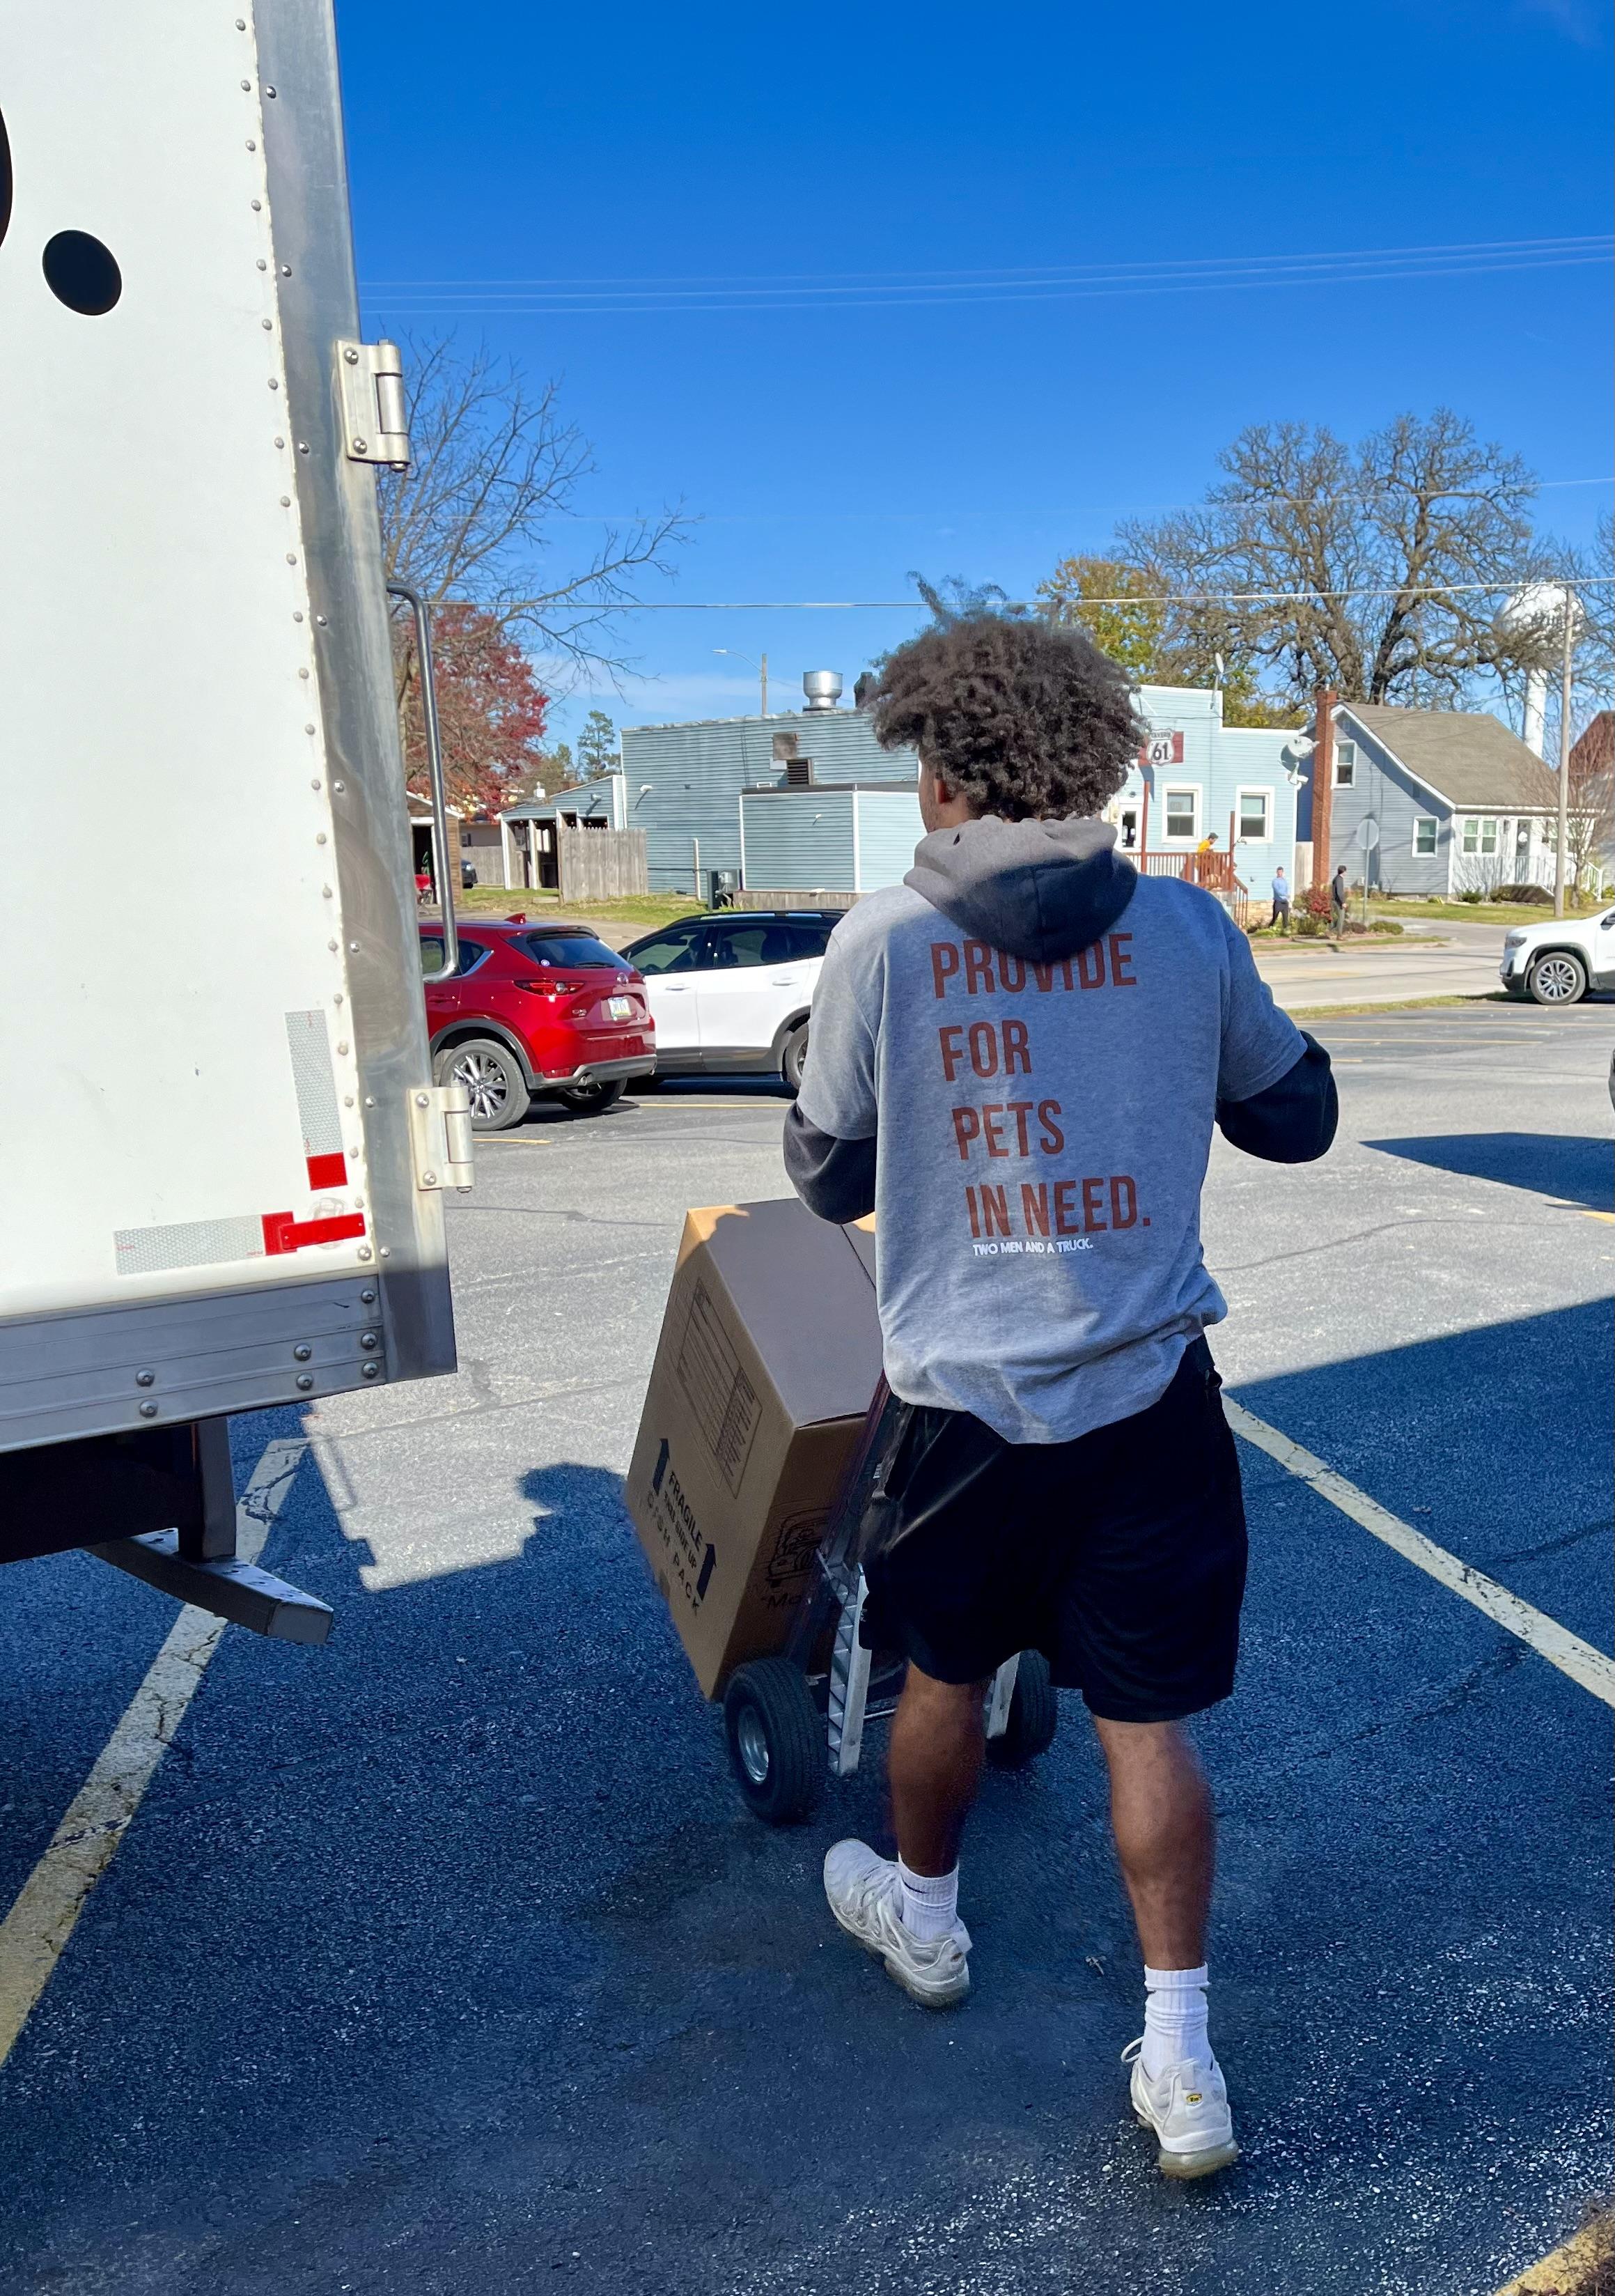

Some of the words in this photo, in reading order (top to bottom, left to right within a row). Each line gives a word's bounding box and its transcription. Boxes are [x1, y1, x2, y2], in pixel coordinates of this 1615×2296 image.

[1153, 742, 1169, 761] 61
[930, 933, 1137, 999] PROVIDE
[939, 1020, 1032, 1081] FOR
[951, 1099, 1065, 1160] PETS
[965, 1184, 1011, 1238] IN
[1020, 1175, 1150, 1237] NEED.
[973, 1243, 998, 1256] TWO
[1001, 1241, 1023, 1253] MEN
[1025, 1241, 1045, 1253] AND
[1047, 1242, 1055, 1253] A
[1056, 1238, 1093, 1253] TRUCK.
[669, 1471, 703, 1552] FRAGILE
[675, 1519, 689, 1551] SIDE
[688, 1548, 697, 1569] UP
[673, 1552, 699, 1616] PACK
